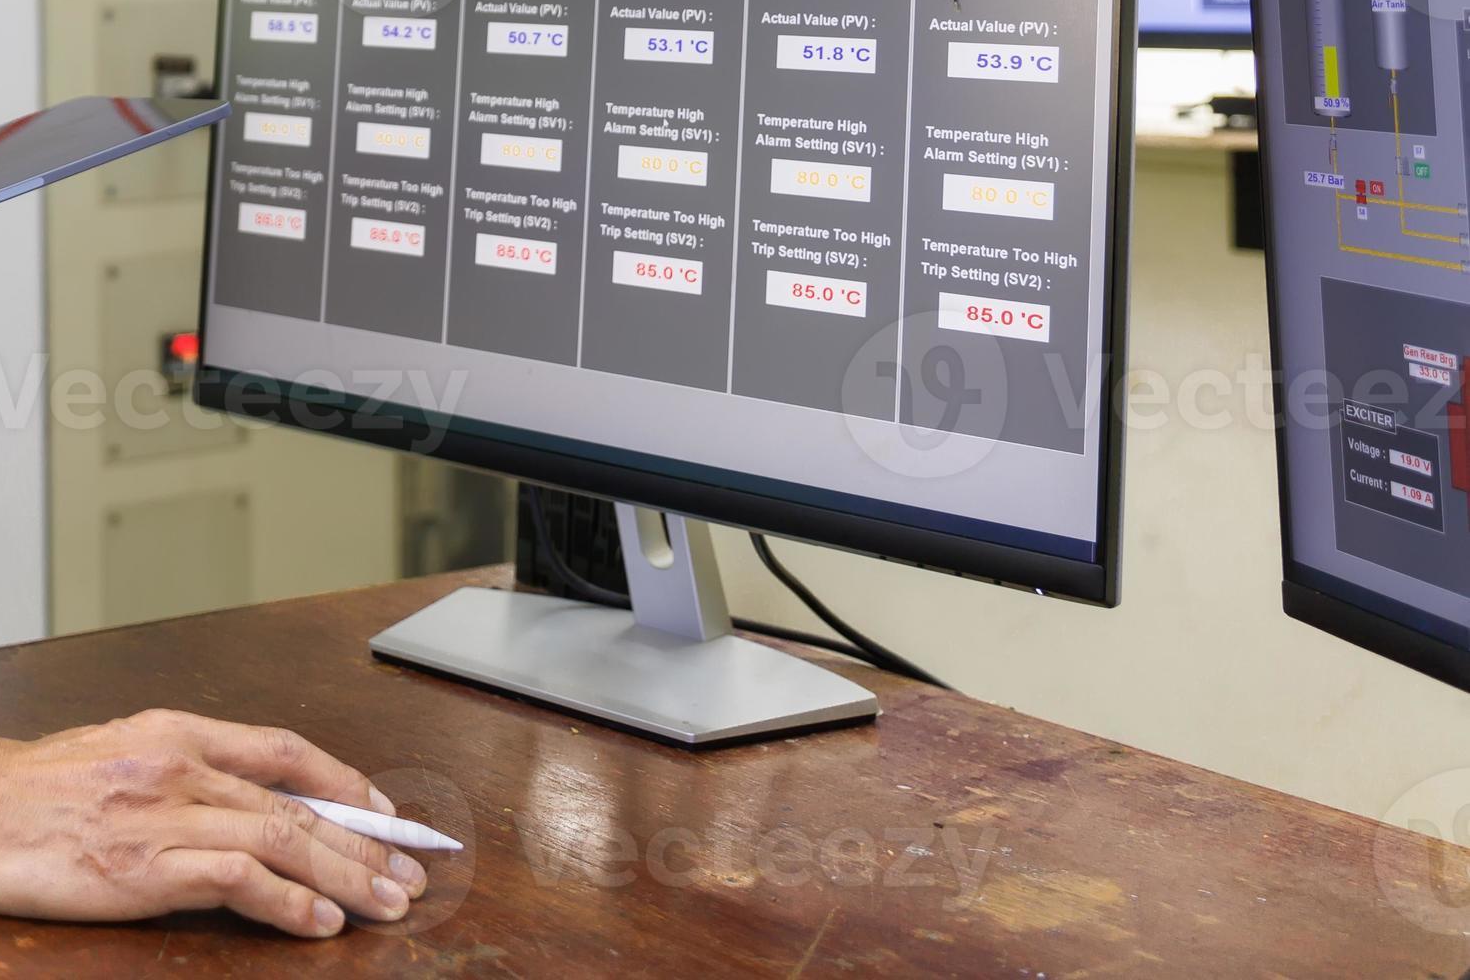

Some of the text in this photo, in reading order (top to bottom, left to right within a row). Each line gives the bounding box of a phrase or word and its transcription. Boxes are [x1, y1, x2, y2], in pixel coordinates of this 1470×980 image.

[474, 1, 507, 14] Actual
[509, 2, 538, 15] Value
[610, 6, 646, 19] Actual
[648, 8, 679, 20] Value
[1372, 0, 1405, 9] Air Tank
[761, 11, 801, 25] Actual
[802, 13, 838, 26] Value
[929, 18, 972, 31] Actual
[975, 20, 1015, 34] Value
[508, 31, 541, 46] 50.7
[647, 38, 682, 52] 53.1
[802, 45, 843, 60] 51.8
[976, 54, 1022, 69] 53.9
[470, 92, 559, 112] Temperature High
[468, 111, 498, 123] Alarm
[500, 113, 536, 129] Setting
[605, 102, 703, 123] Temperature High
[603, 121, 636, 135] Alarm
[639, 124, 678, 141] Setting
[757, 113, 867, 135] Temperature High
[755, 133, 790, 148] Alarm
[795, 137, 839, 154] Setting
[925, 126, 1049, 149] Temperature High
[502, 144, 534, 158] 800
[923, 147, 963, 161] Alarm
[968, 150, 1017, 169] Setting
[641, 156, 678, 172] 800
[797, 171, 838, 186] 800
[1328, 175, 1343, 186] Bar
[465, 188, 576, 214] Temperature Too High
[971, 186, 1017, 203] 800
[464, 208, 483, 221] Trip
[485, 211, 520, 228] Setting
[601, 202, 725, 229] Temperature Too High
[600, 224, 621, 239] Trip
[624, 227, 663, 245] Setting
[752, 219, 890, 248] Temperature Too High
[496, 244, 530, 260] 85.0
[751, 241, 775, 258] Trip
[778, 245, 821, 264] Setting
[922, 238, 1077, 269] Temperature Too High
[635, 262, 672, 280] 85.0
[921, 262, 947, 279] Trip
[951, 266, 999, 286] Setting
[792, 283, 833, 301] 85.0
[966, 306, 1013, 325] 85.0
[1403, 345, 1418, 357] Gen
[1420, 349, 1437, 362] Rear
[1419, 366, 1437, 379] 33.0
[1345, 404, 1393, 427] EXCITER
[1347, 437, 1430, 471] Voltage 19.0 V
[1349, 469, 1382, 489] Current
[1402, 486, 1421, 500] 1.09
